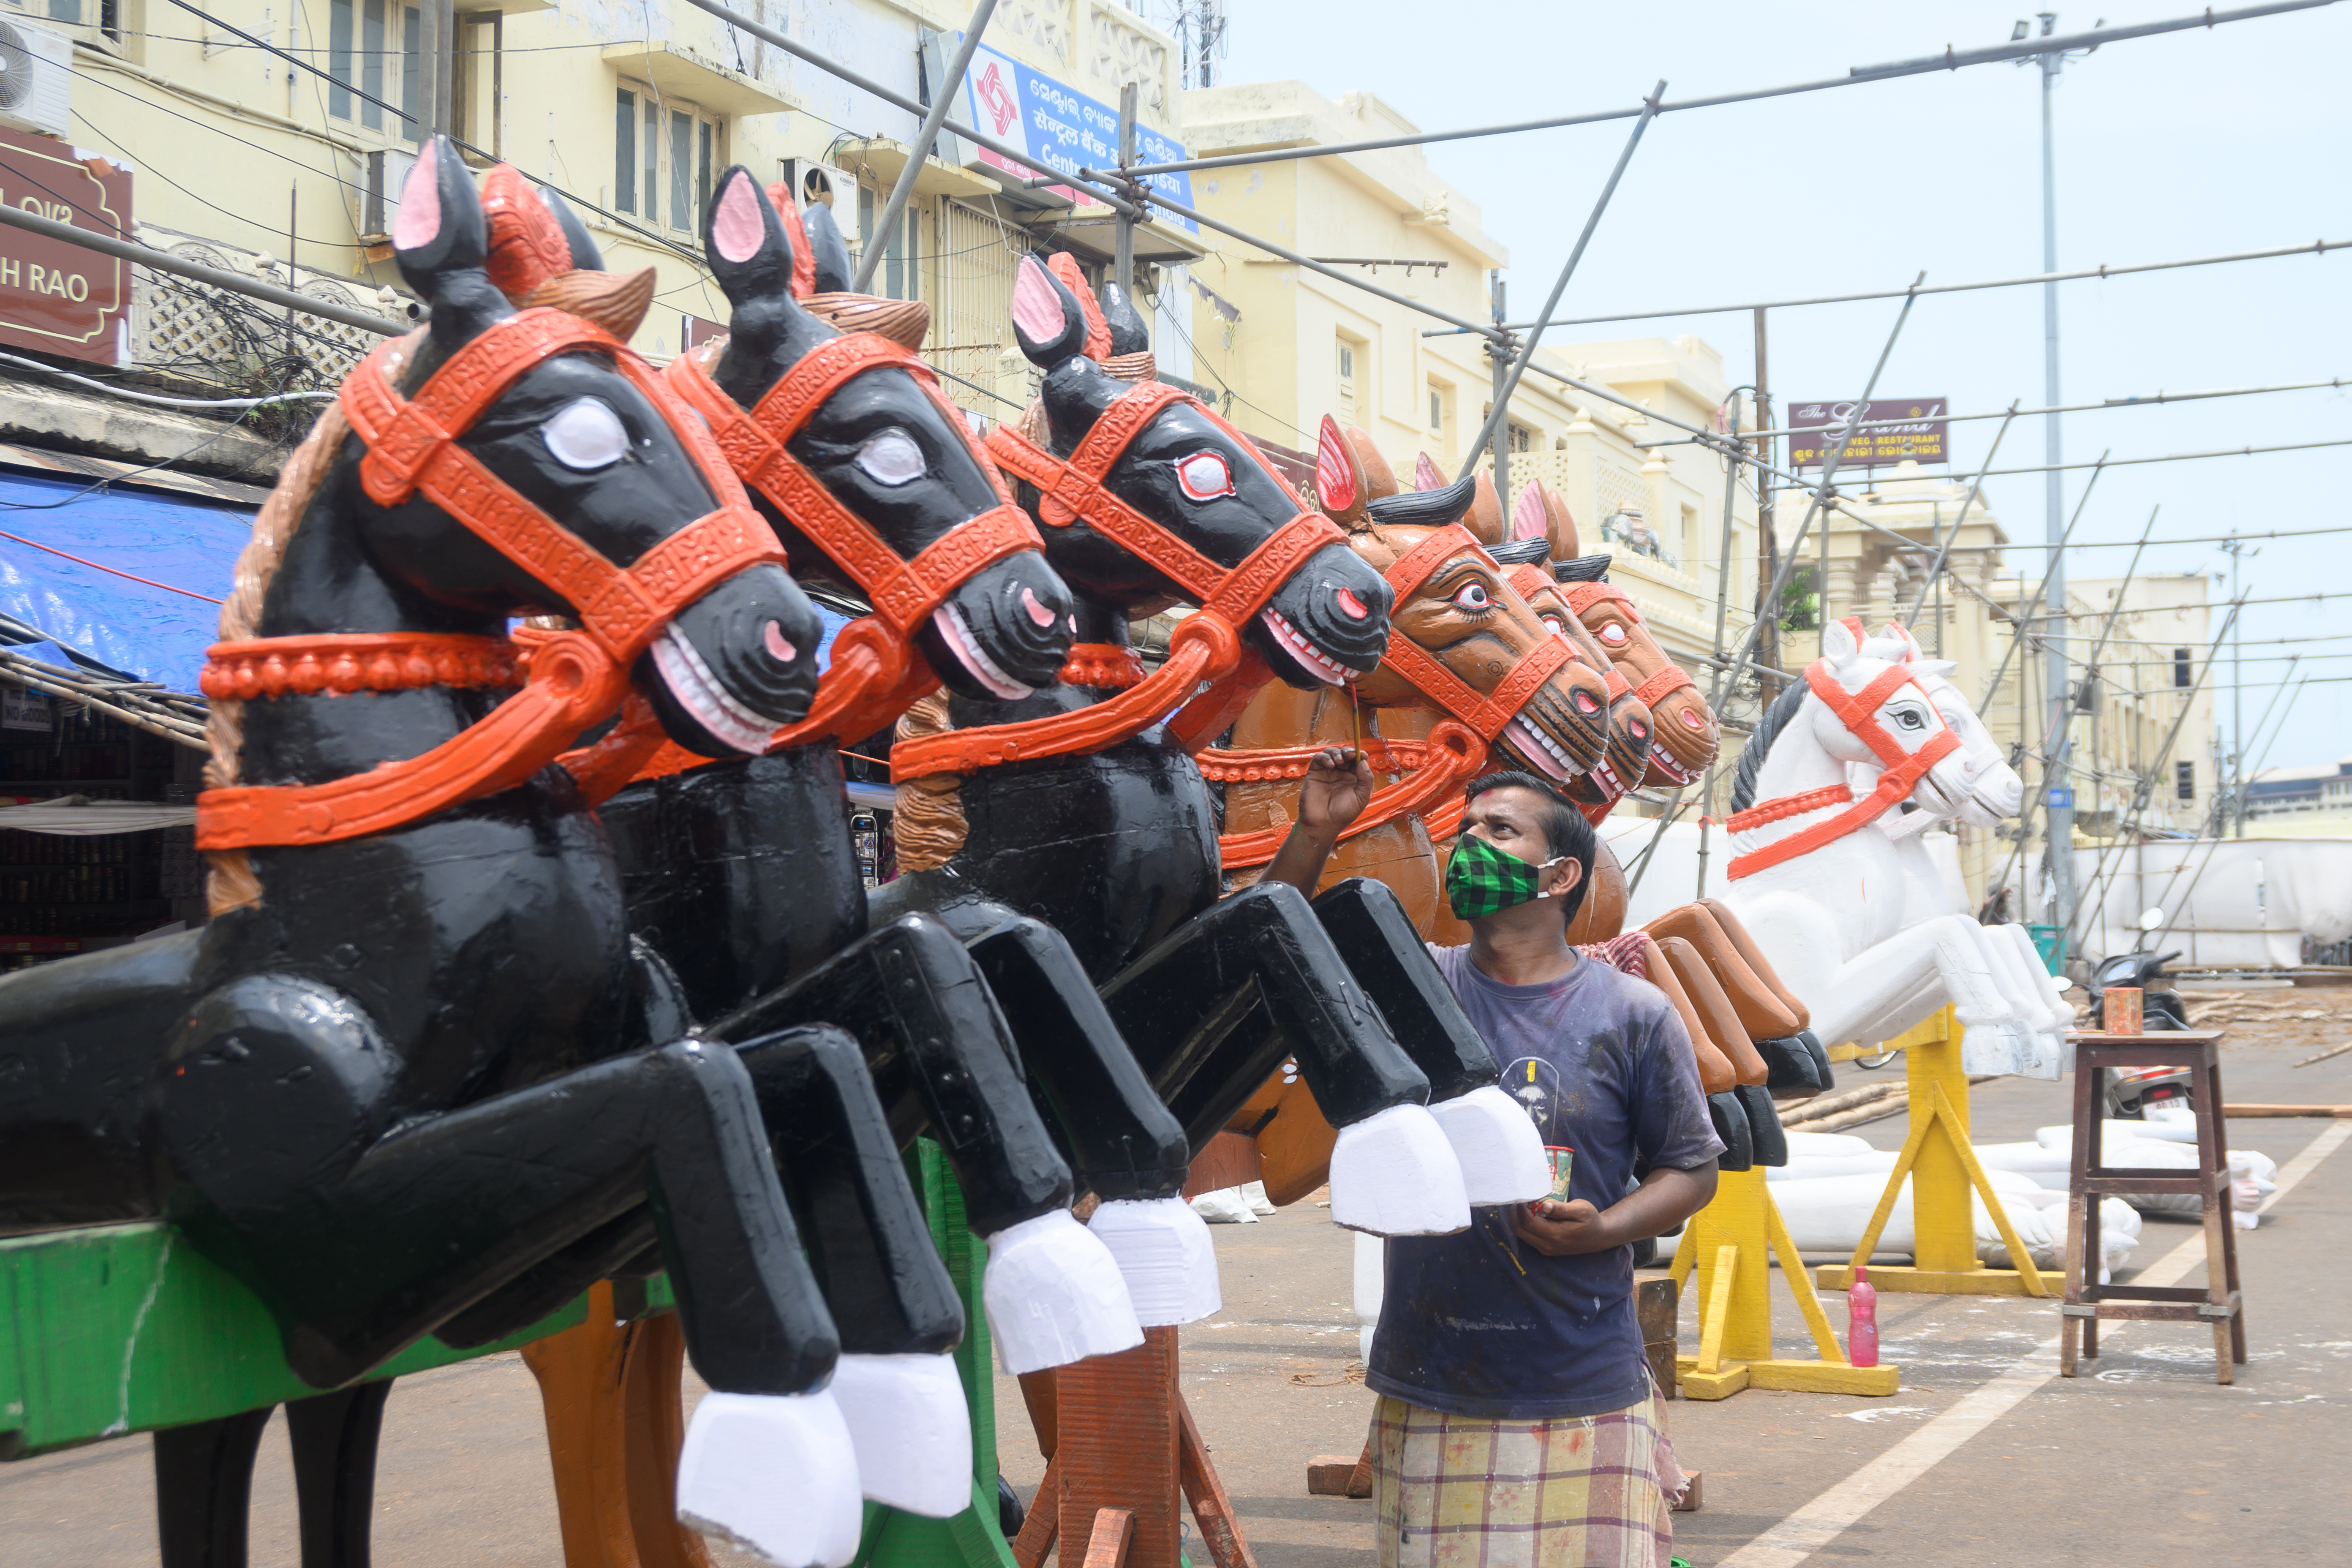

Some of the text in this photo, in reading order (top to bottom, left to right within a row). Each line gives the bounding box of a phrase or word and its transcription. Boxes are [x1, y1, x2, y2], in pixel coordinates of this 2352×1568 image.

[1033, 106, 1078, 147] सेन्ट्रल
[1080, 128, 1107, 158] बैंक
[1042, 143, 1093, 184] Centrl
[28, 263, 89, 302] RAO
[1799, 404, 1827, 418] The
[1851, 437, 1874, 446] VEG.
[5, 705, 19, 721] NO
